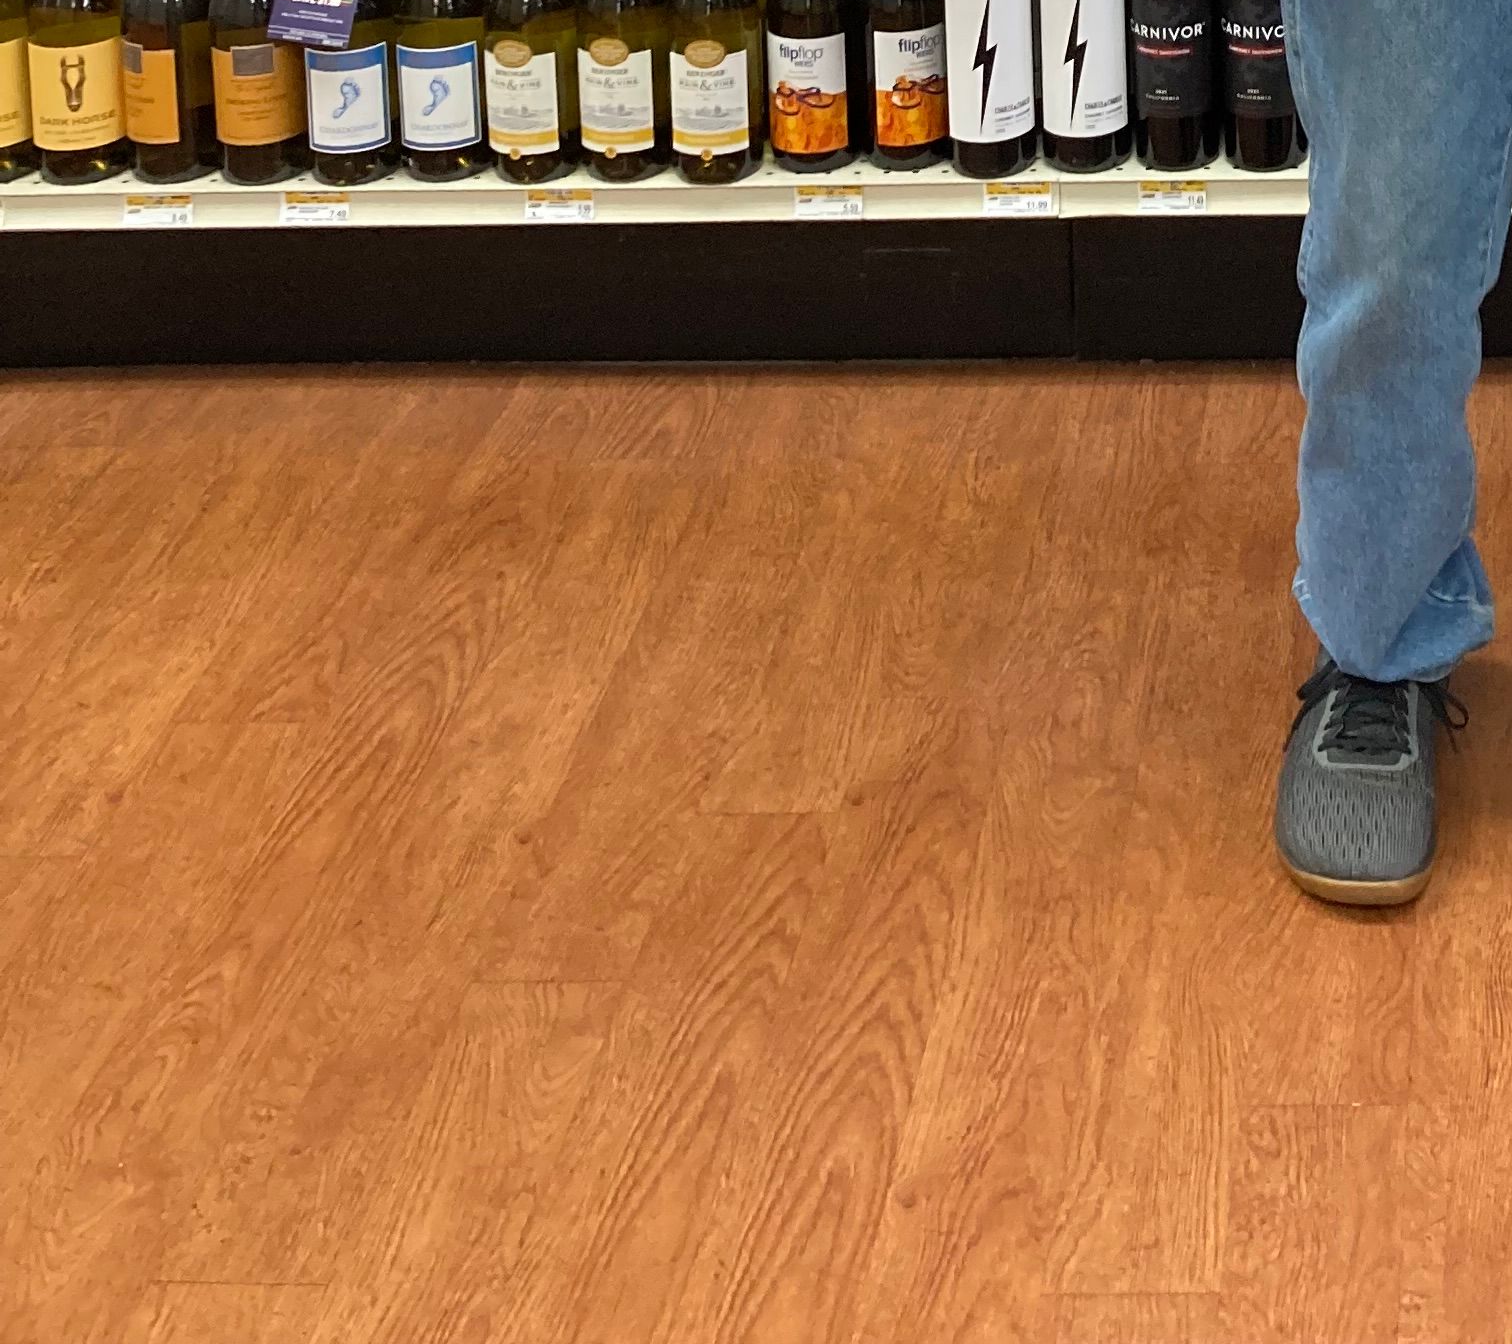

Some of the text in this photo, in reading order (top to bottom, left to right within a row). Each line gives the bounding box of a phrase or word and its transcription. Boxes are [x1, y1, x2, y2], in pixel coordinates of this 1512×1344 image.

[1130, 18, 1202, 40] CARNIVOR
[778, 43, 824, 62] flipflop
[898, 34, 943, 54] flipflop
[40, 115, 73, 126] DARK
[75, 110, 116, 124] HORSE
[1026, 200, 1048, 209] 11.99
